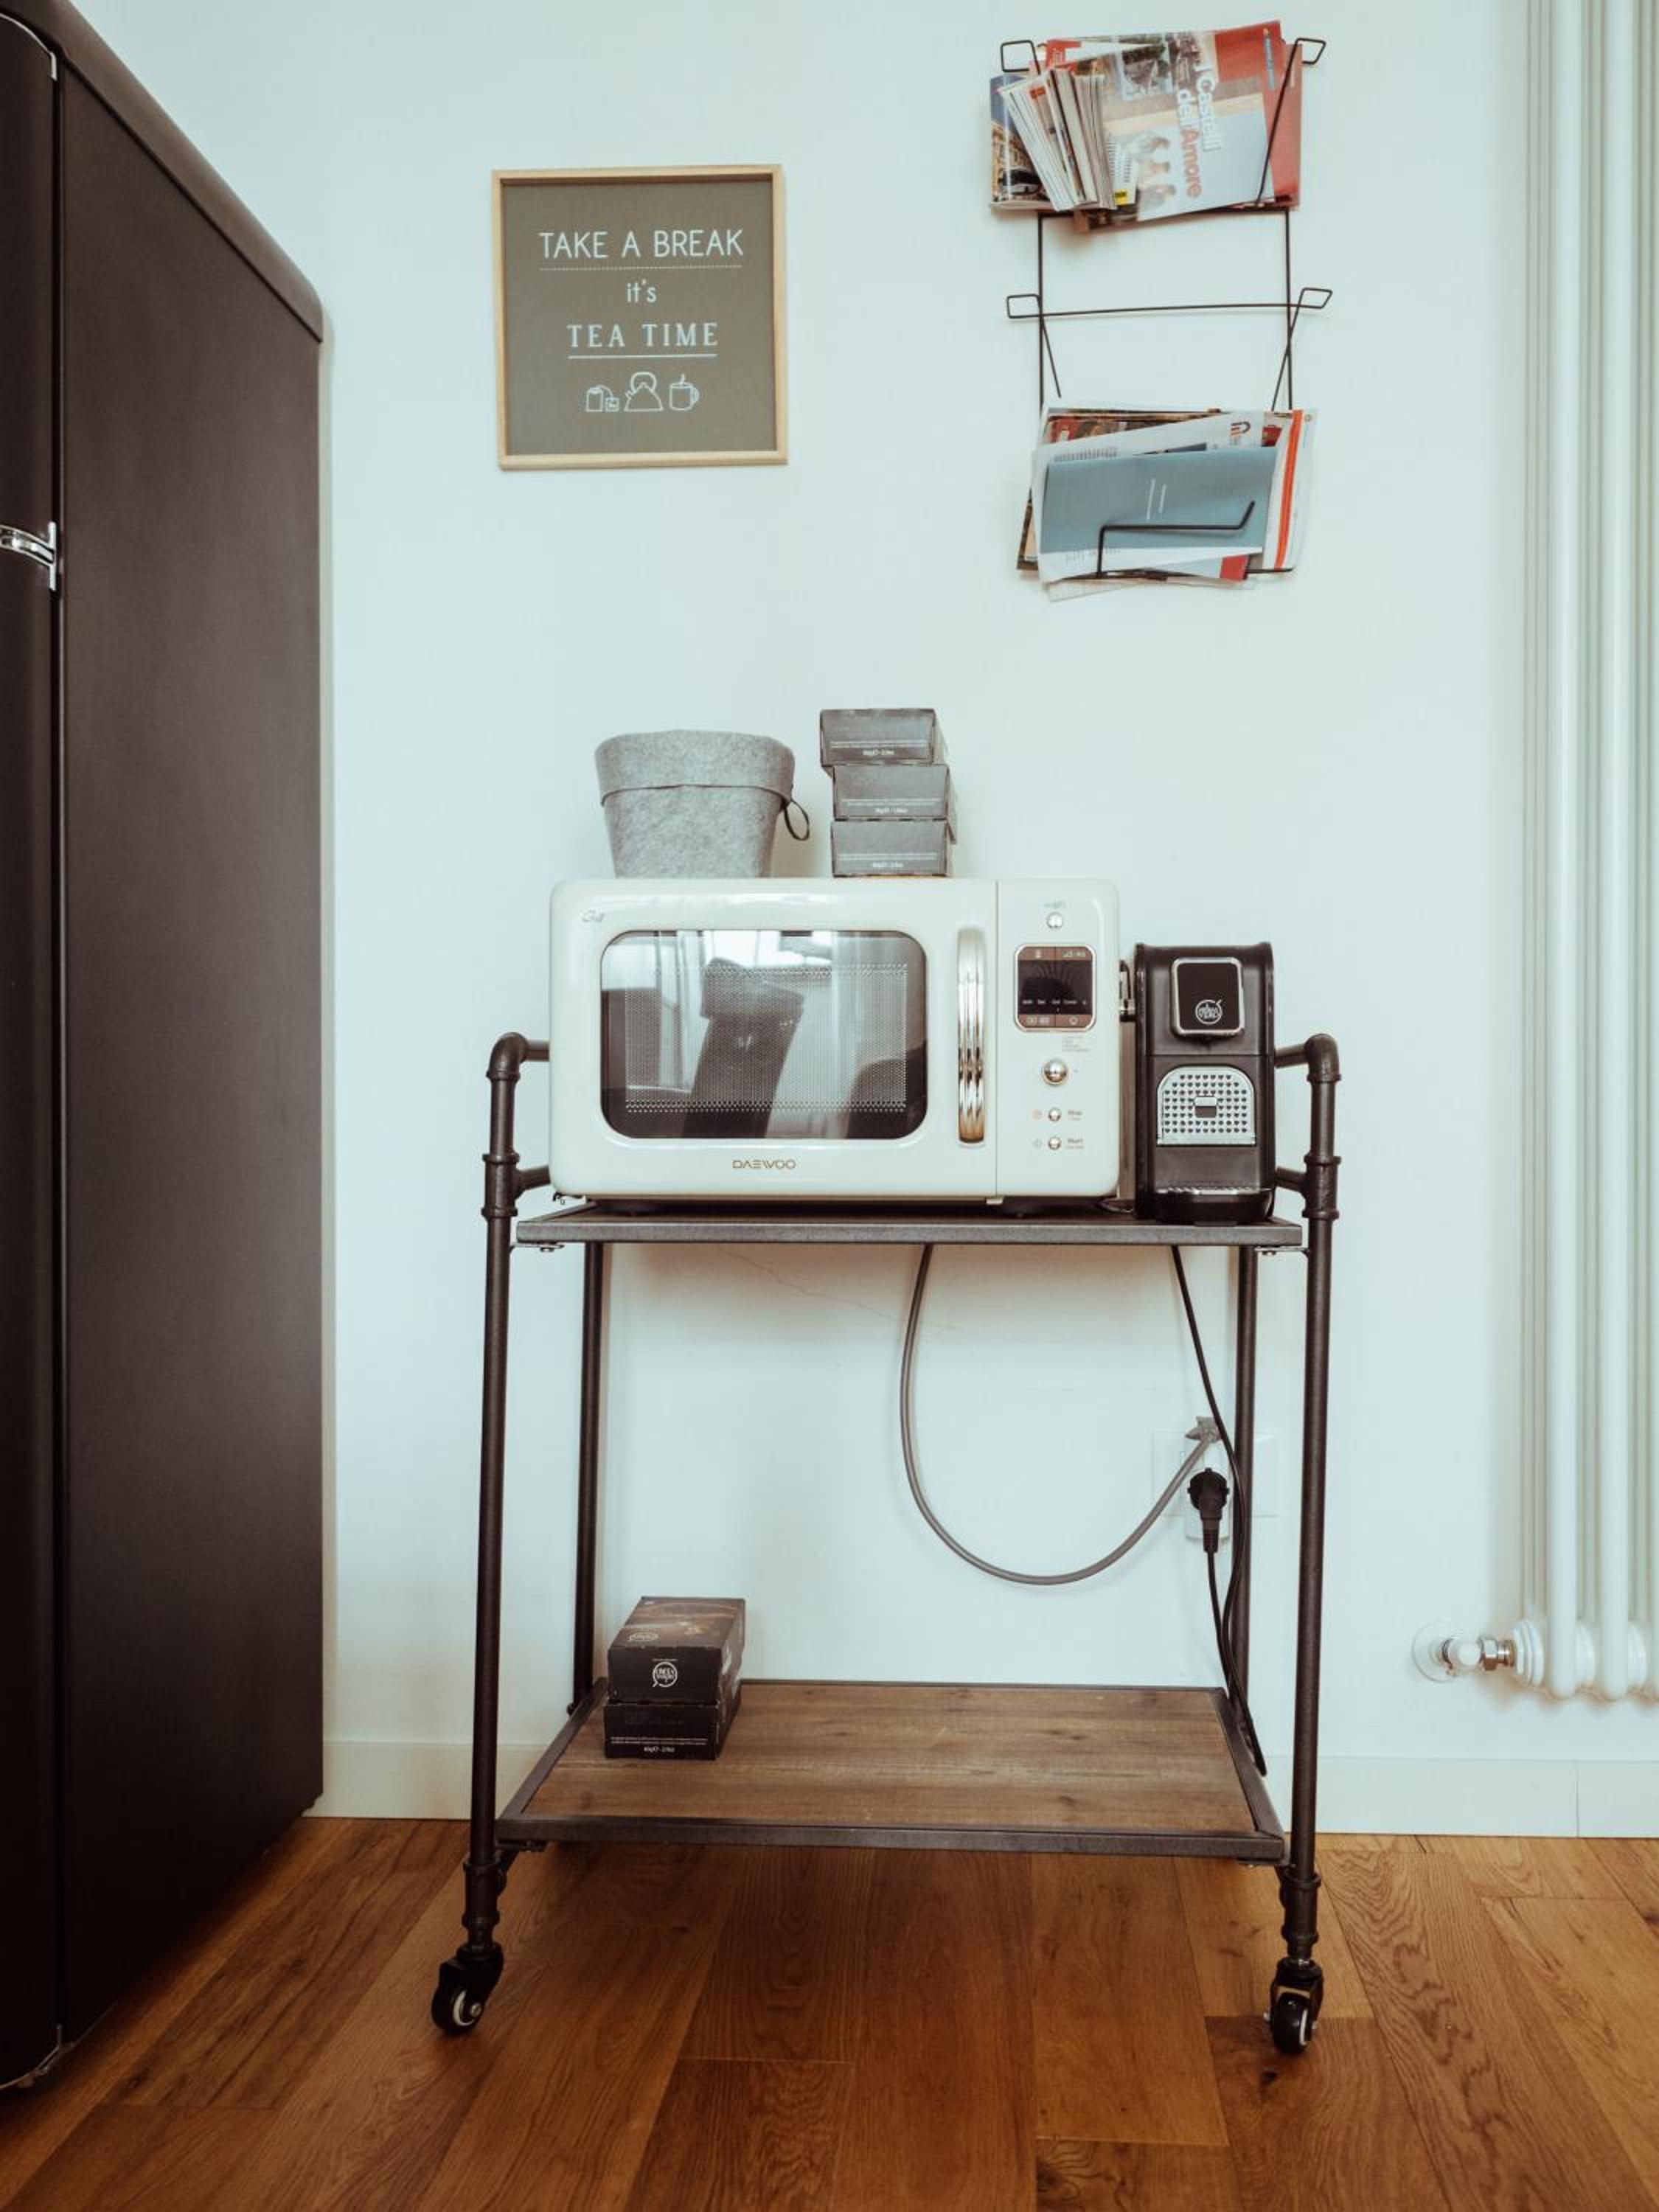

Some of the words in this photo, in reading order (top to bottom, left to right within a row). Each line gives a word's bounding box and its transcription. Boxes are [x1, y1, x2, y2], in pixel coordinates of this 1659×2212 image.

[538, 231, 608, 259] TAKE
[621, 231, 641, 258] A
[654, 229, 743, 257] BREAK
[627, 279, 657, 303] it's
[567, 324, 625, 347] TEA
[642, 322, 718, 347] TIME
[732, 1160, 796, 1169] DAEWOO
